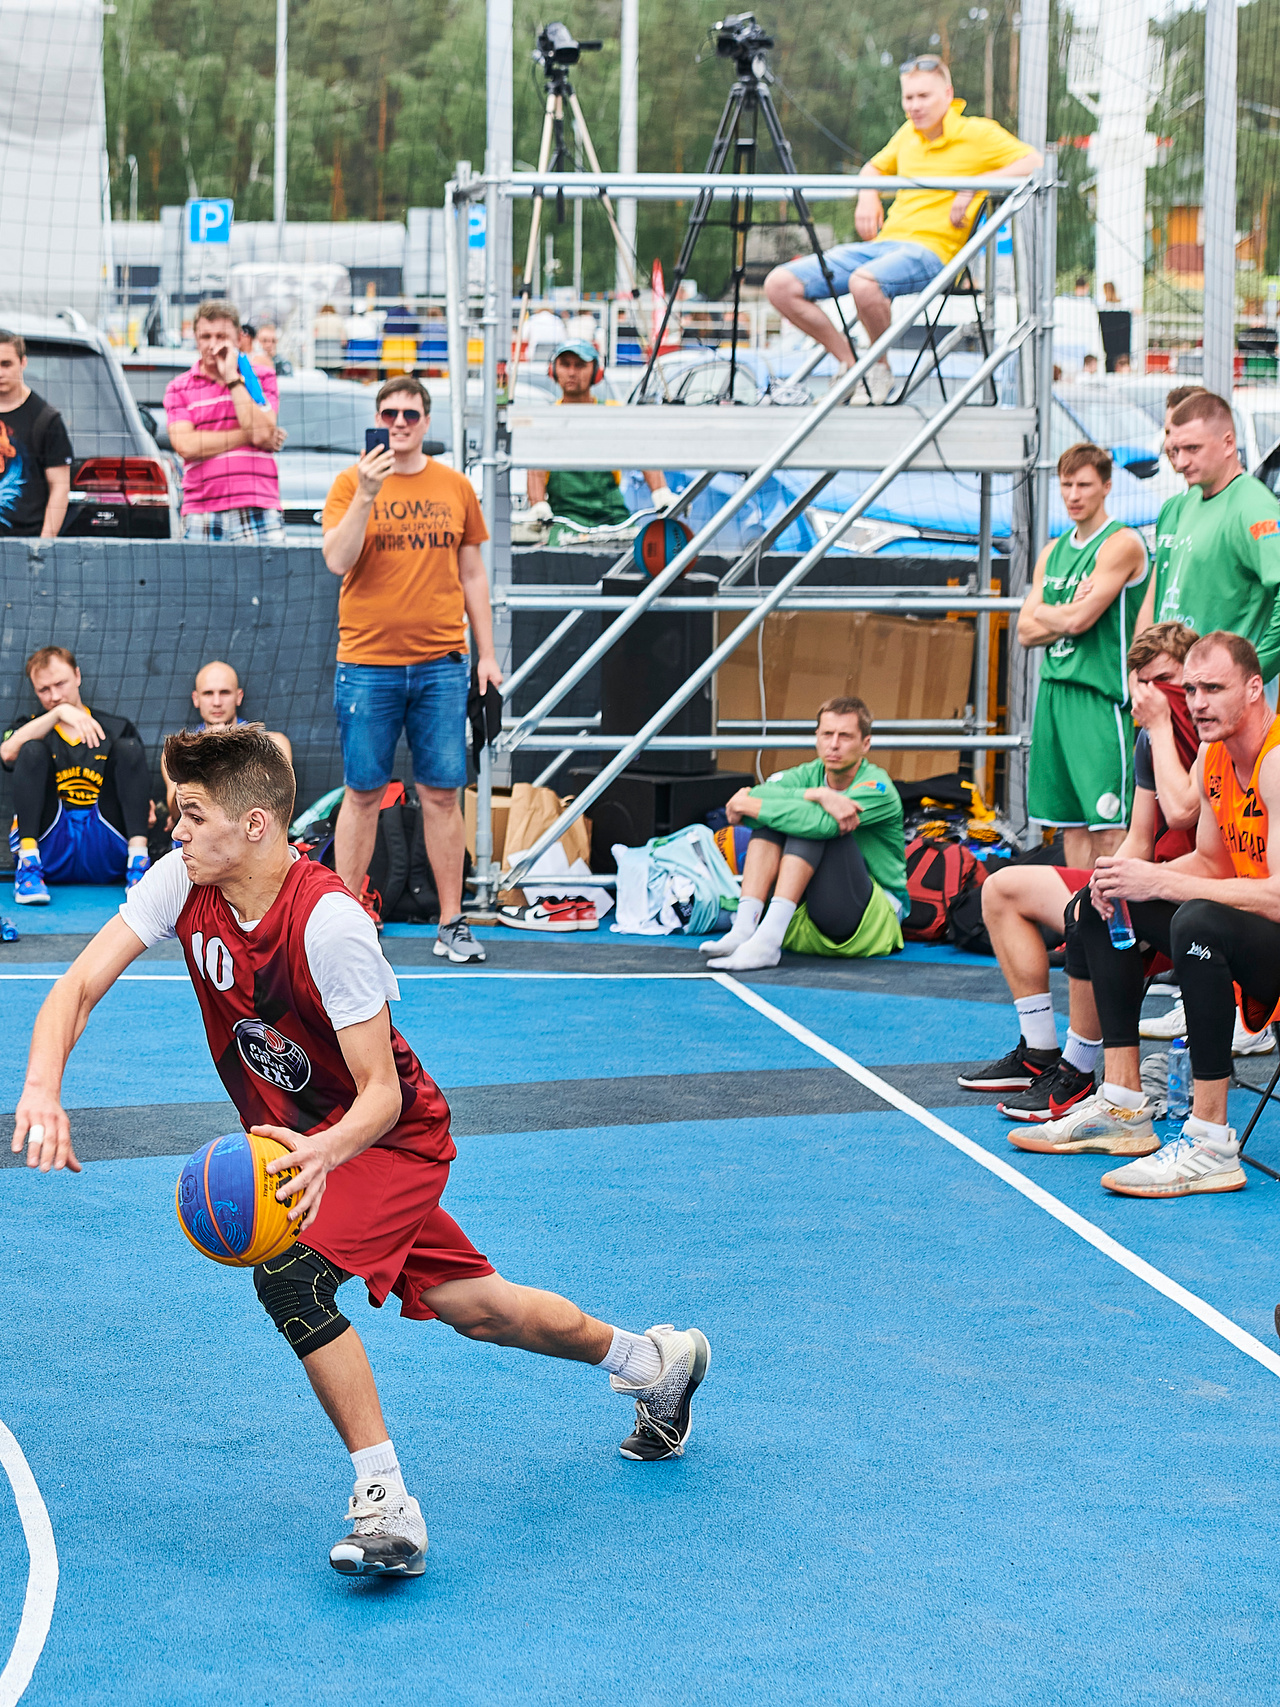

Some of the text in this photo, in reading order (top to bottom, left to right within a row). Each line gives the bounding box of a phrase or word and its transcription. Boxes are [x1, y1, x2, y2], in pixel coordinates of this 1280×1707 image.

[199, 204, 224, 242] P
[373, 500, 429, 519] HOW
[407, 531, 455, 550] WILD
[191, 930, 235, 992] 10
